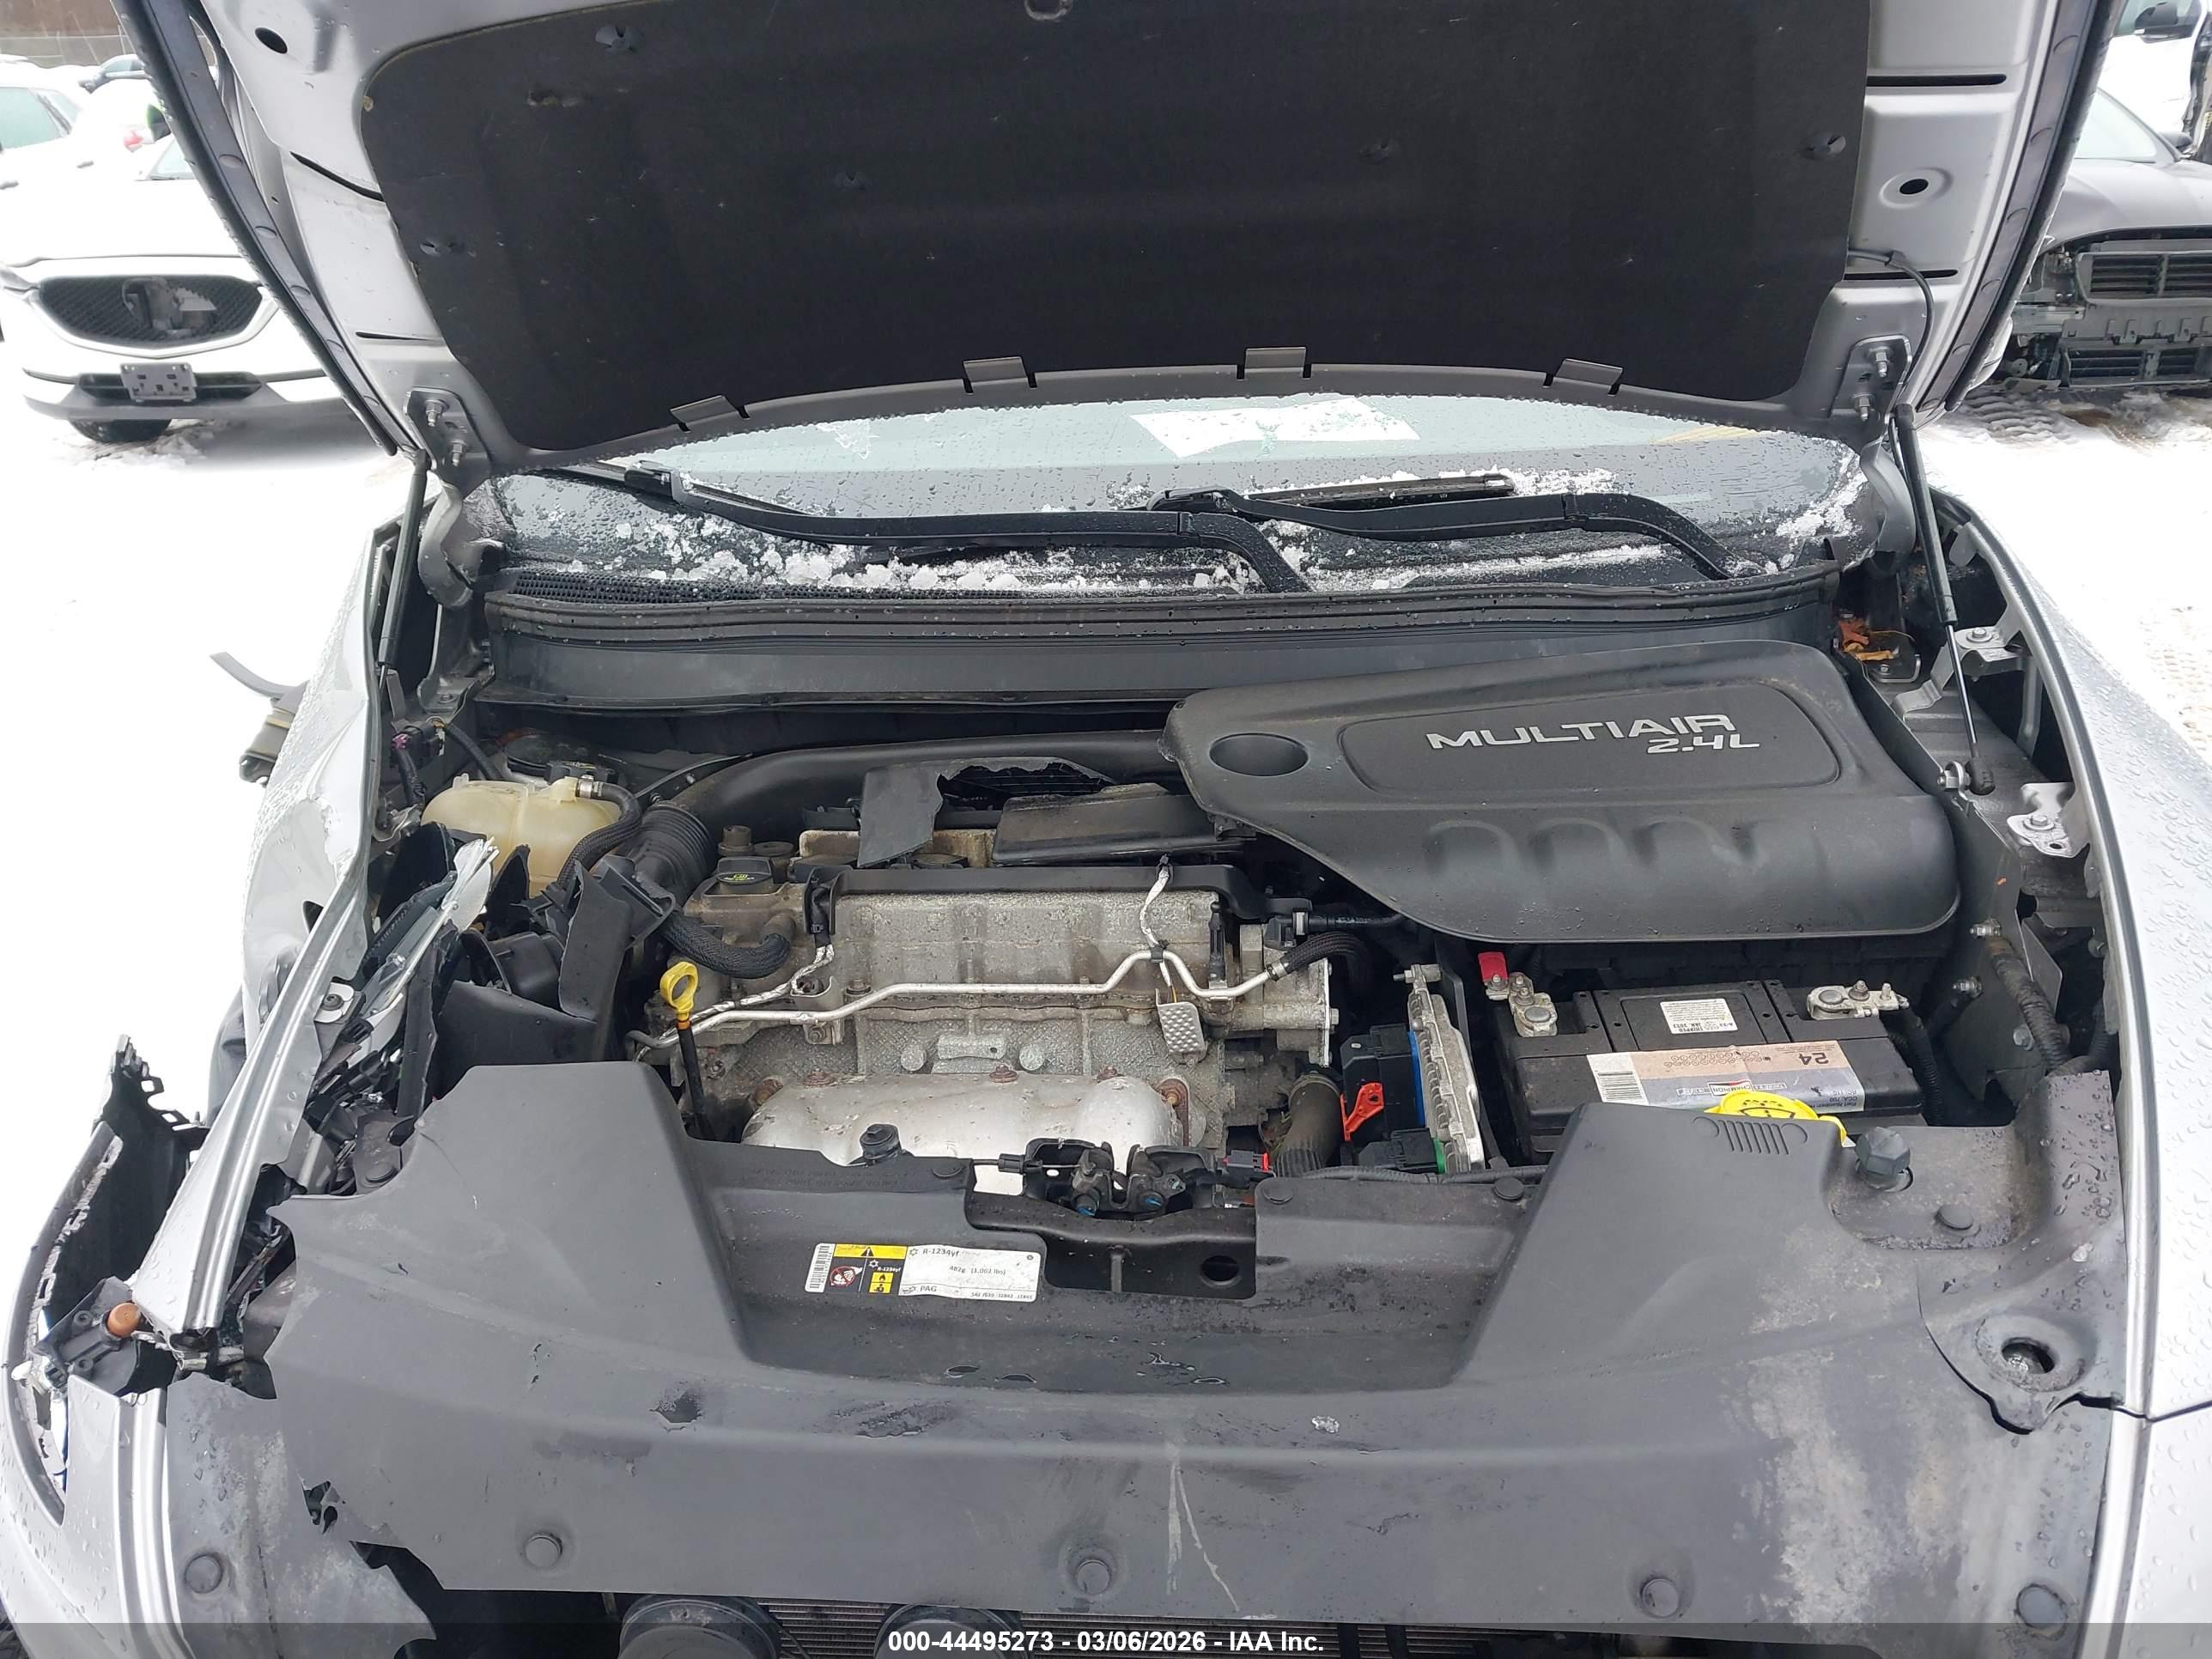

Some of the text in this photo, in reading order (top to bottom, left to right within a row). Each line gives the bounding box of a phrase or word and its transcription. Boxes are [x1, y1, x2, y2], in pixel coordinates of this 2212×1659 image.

[1425, 714, 1737, 750] MULTIAIR
[1646, 733, 1760, 754] 2.4L
[1798, 1052, 1830, 1066] 24
[1712, 1084, 1752, 1094] CHAMPION
[922, 1248, 960, 1257] R-1234yf
